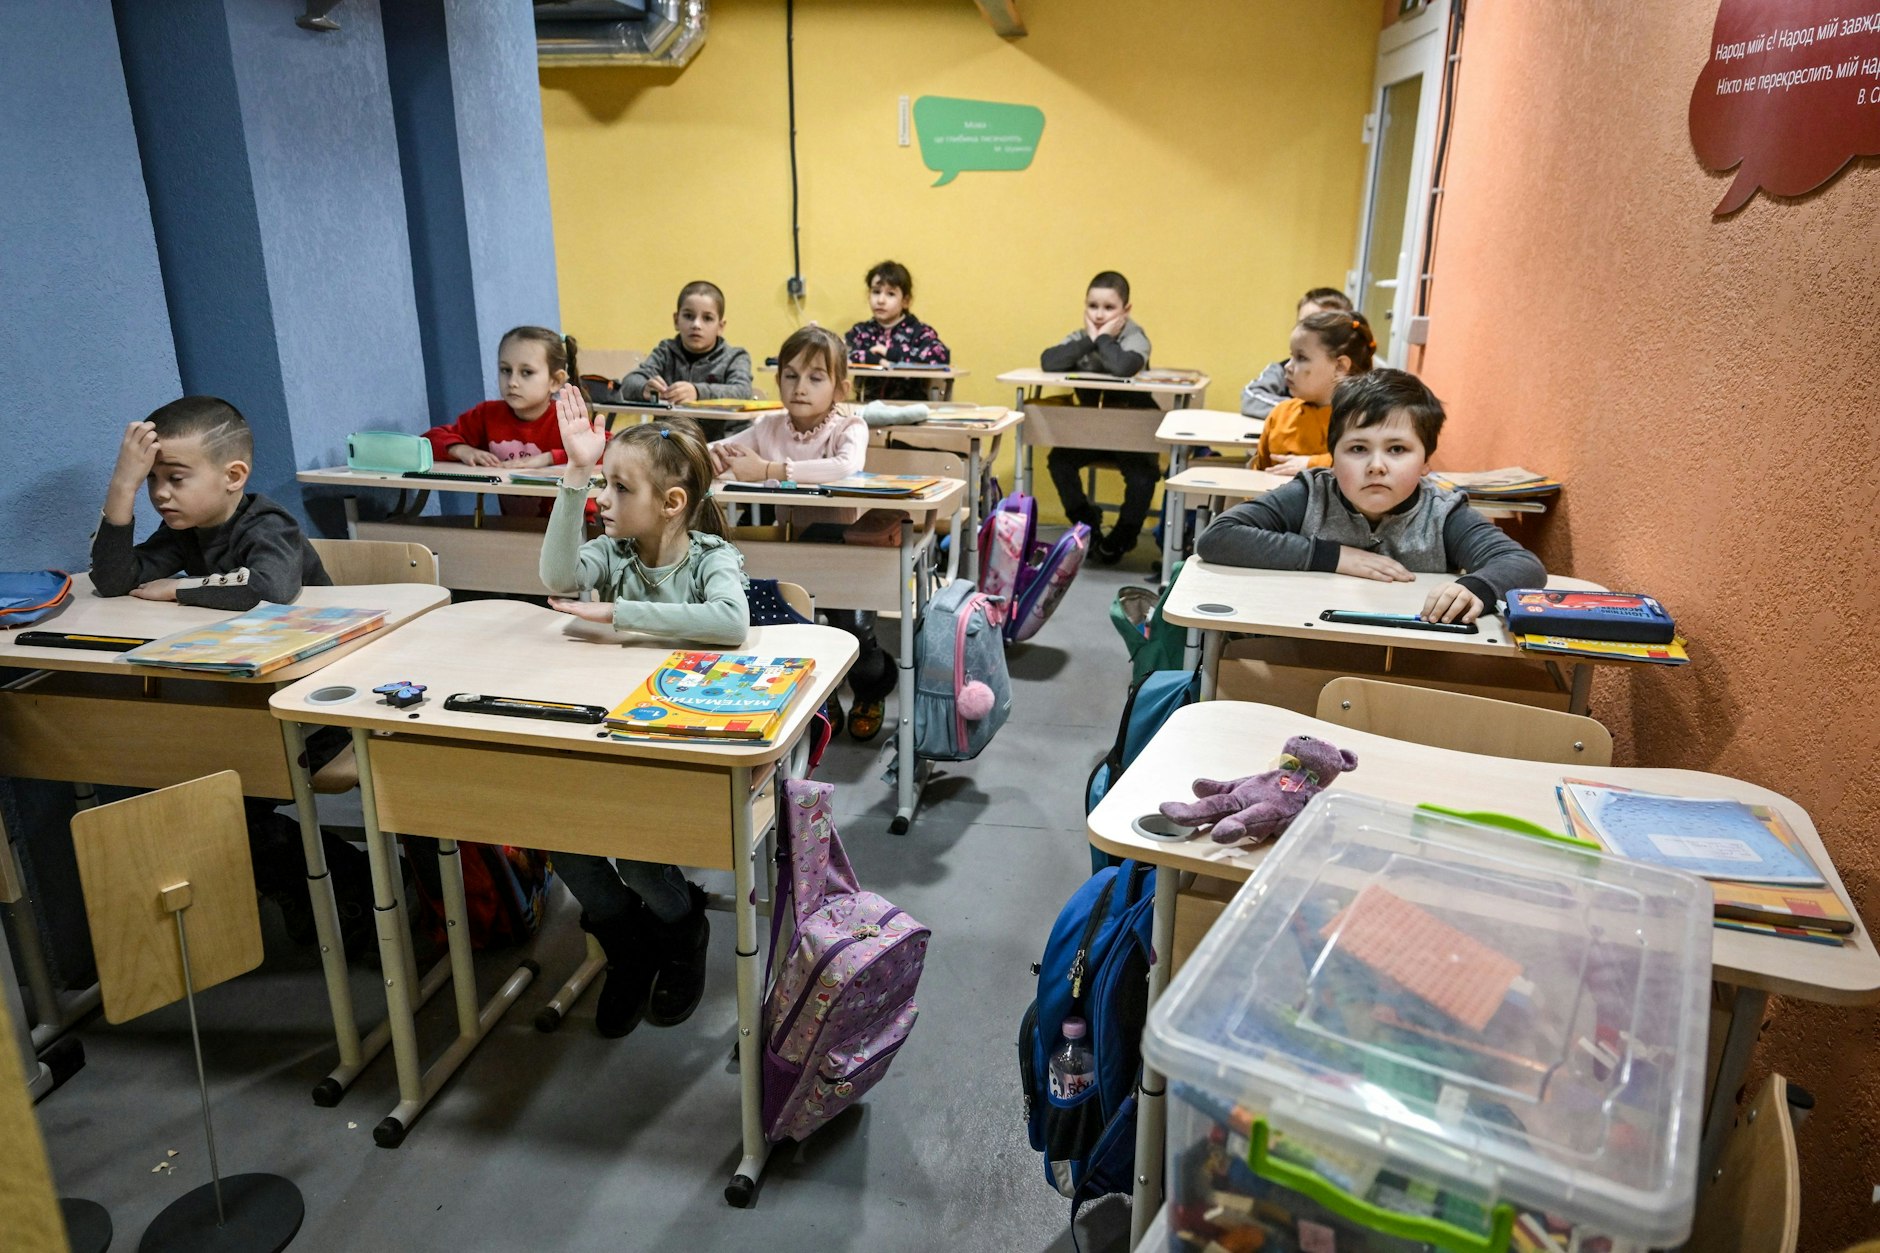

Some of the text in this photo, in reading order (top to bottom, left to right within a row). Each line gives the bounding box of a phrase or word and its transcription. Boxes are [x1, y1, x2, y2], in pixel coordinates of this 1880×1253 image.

[1715, 44, 1745, 64] Народ
[1747, 33, 1765, 55] мій
[1766, 29, 1778, 51] є!
[1778, 27, 1814, 52] Народ
[1817, 17, 1839, 41] мій
[1716, 77, 1742, 95] Ніхто
[1743, 75, 1757, 92] не
[1758, 64, 1833, 94] перекреслить
[1835, 55, 1859, 79] мій
[1857, 86, 1880, 105] В. С
[651, 695, 771, 706] МАТЕМАТИКА
